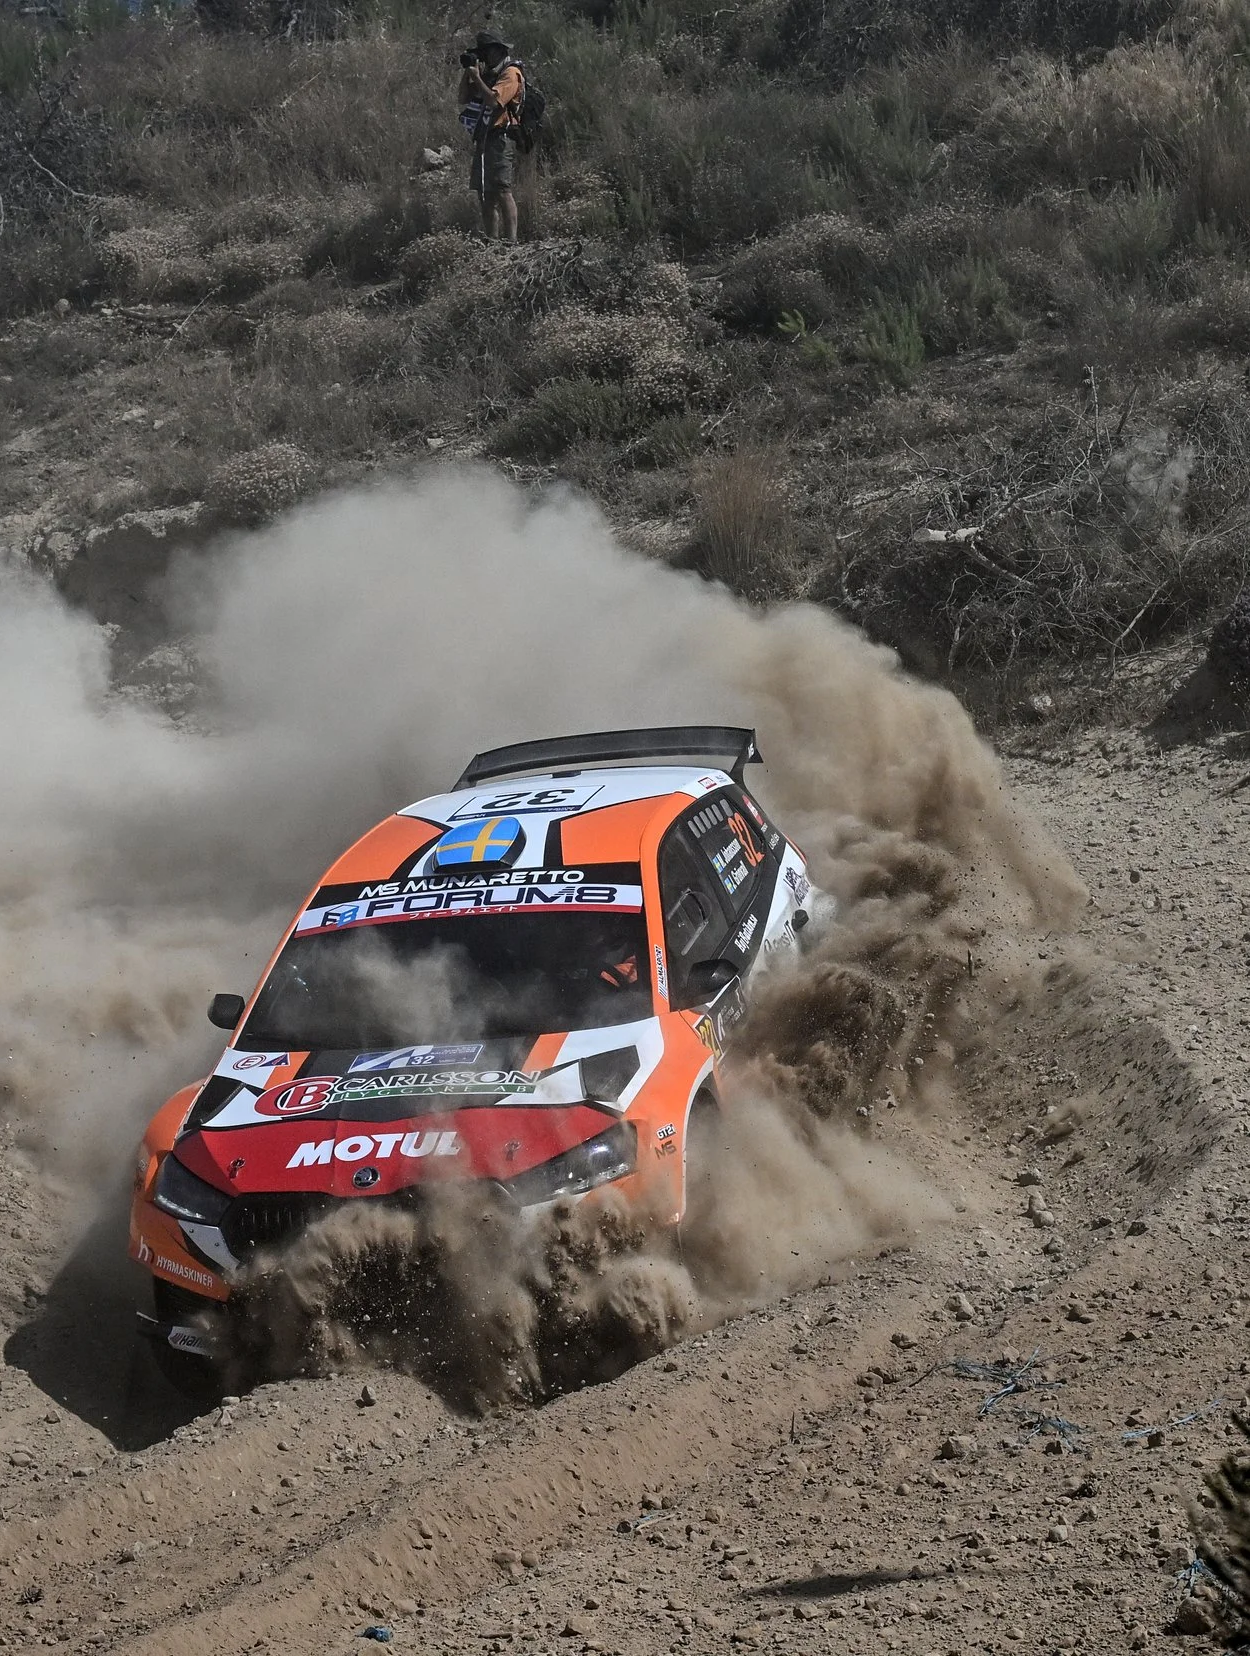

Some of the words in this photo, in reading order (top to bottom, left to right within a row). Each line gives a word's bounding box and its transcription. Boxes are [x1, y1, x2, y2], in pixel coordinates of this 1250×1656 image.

[481, 789, 575, 810] 32
[727, 811, 765, 867] 32
[357, 881, 401, 900] MS
[403, 870, 586, 893] MUNARETTO
[366, 886, 618, 918] FORUM8
[411, 1055, 435, 1065] 32
[334, 1070, 542, 1093] CARLSSON
[493, 1085, 527, 1093] AB
[285, 1131, 461, 1169] MOTUL
[156, 1255, 214, 1288] HYRMASKINER
